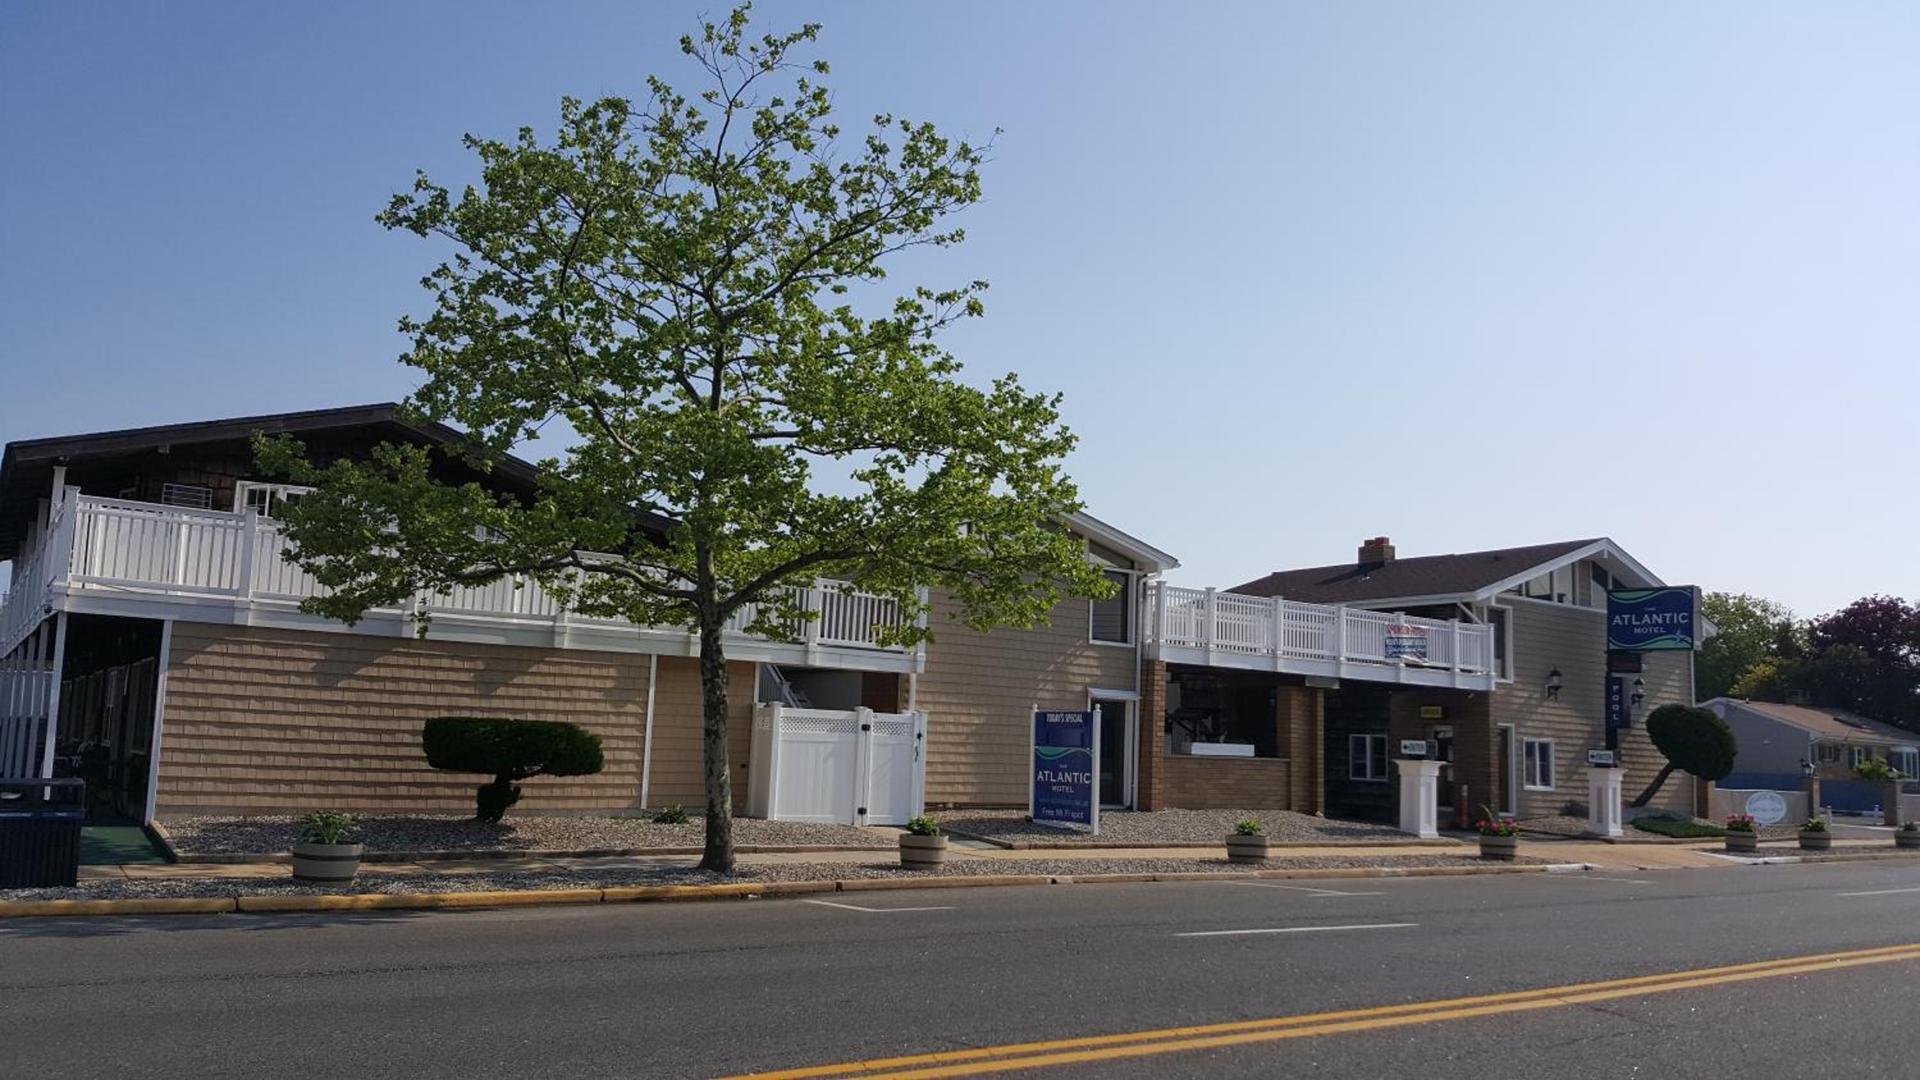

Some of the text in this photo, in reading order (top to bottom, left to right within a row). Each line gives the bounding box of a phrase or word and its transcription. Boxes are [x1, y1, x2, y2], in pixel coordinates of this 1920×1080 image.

[1612, 612, 1688, 625] ATLANTIC
[1633, 626, 1666, 634] MOTEL
[1612, 685, 1620, 720] POOL
[1037, 770, 1091, 784] ATLANTIC
[1051, 785, 1074, 793] MOTEL
